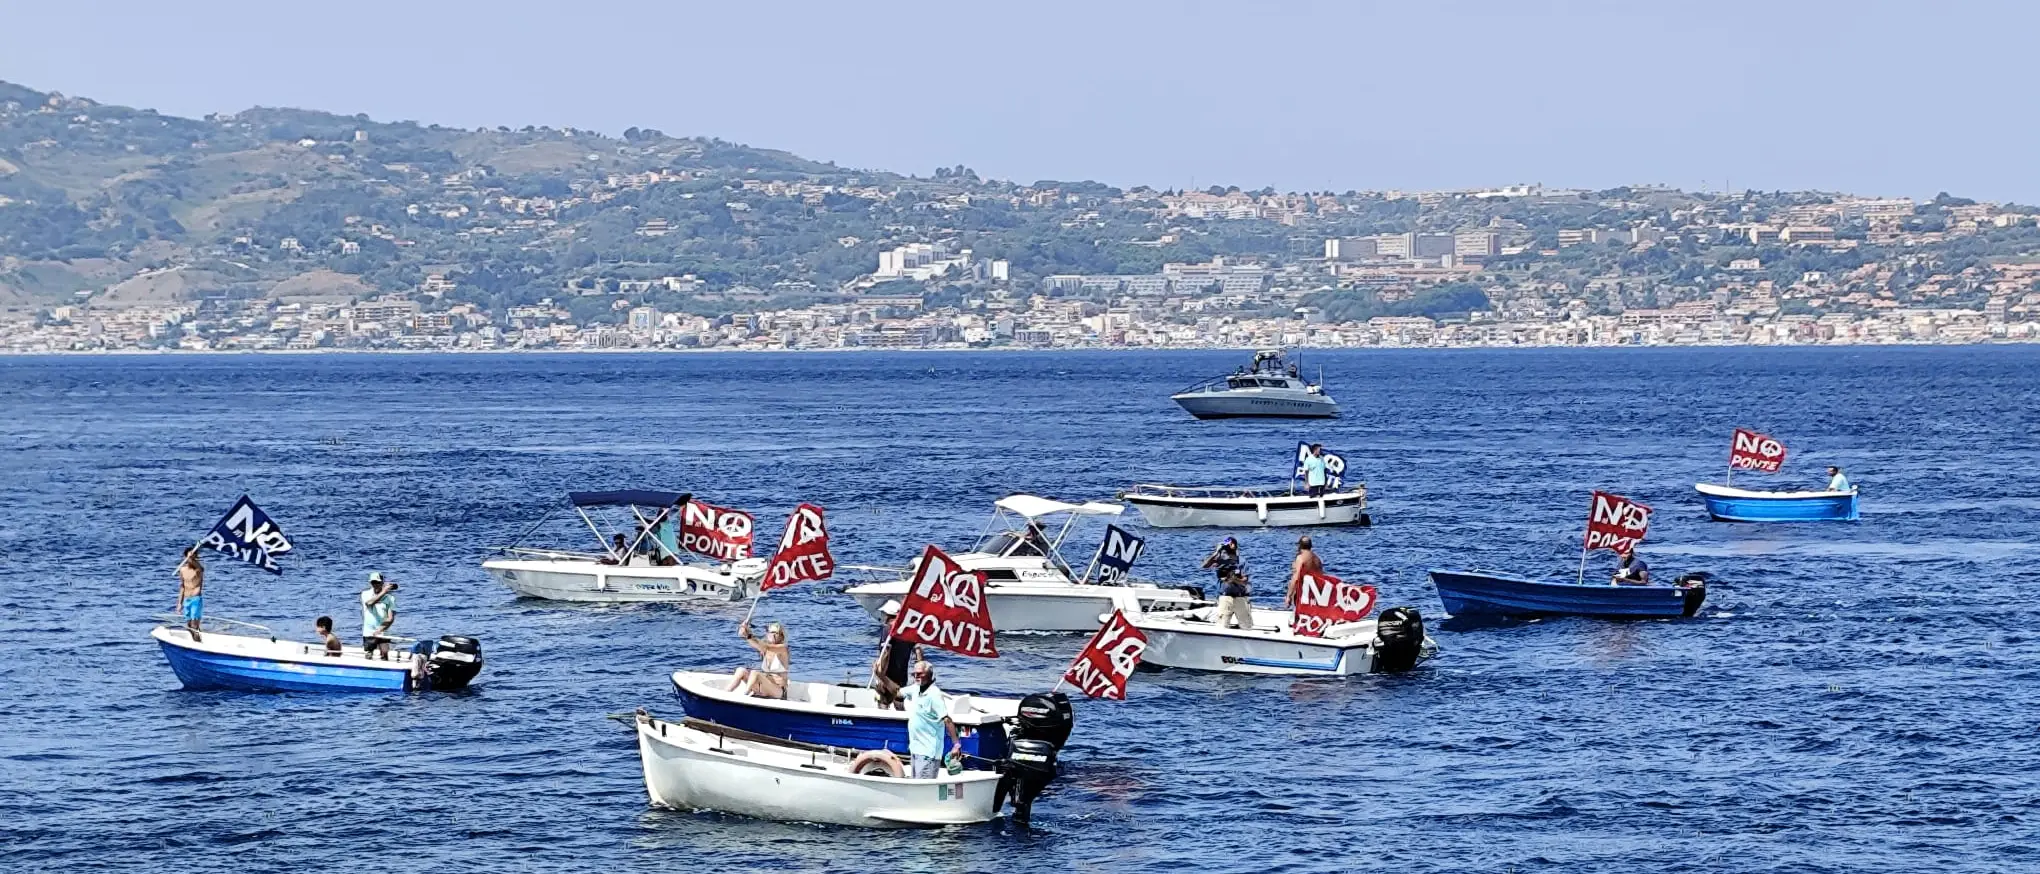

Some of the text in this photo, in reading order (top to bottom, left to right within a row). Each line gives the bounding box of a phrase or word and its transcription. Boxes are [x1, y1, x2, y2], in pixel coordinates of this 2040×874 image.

[1731, 454, 1778, 470] PONTE
[1735, 432, 1782, 458] NO
[685, 501, 752, 538] NO
[1594, 495, 1648, 532] NO
[683, 532, 748, 560] PONTE
[1106, 530, 1144, 563] N
[916, 555, 980, 619] NO
[1300, 574, 1370, 615] NO
[897, 608, 994, 654] PONTE
